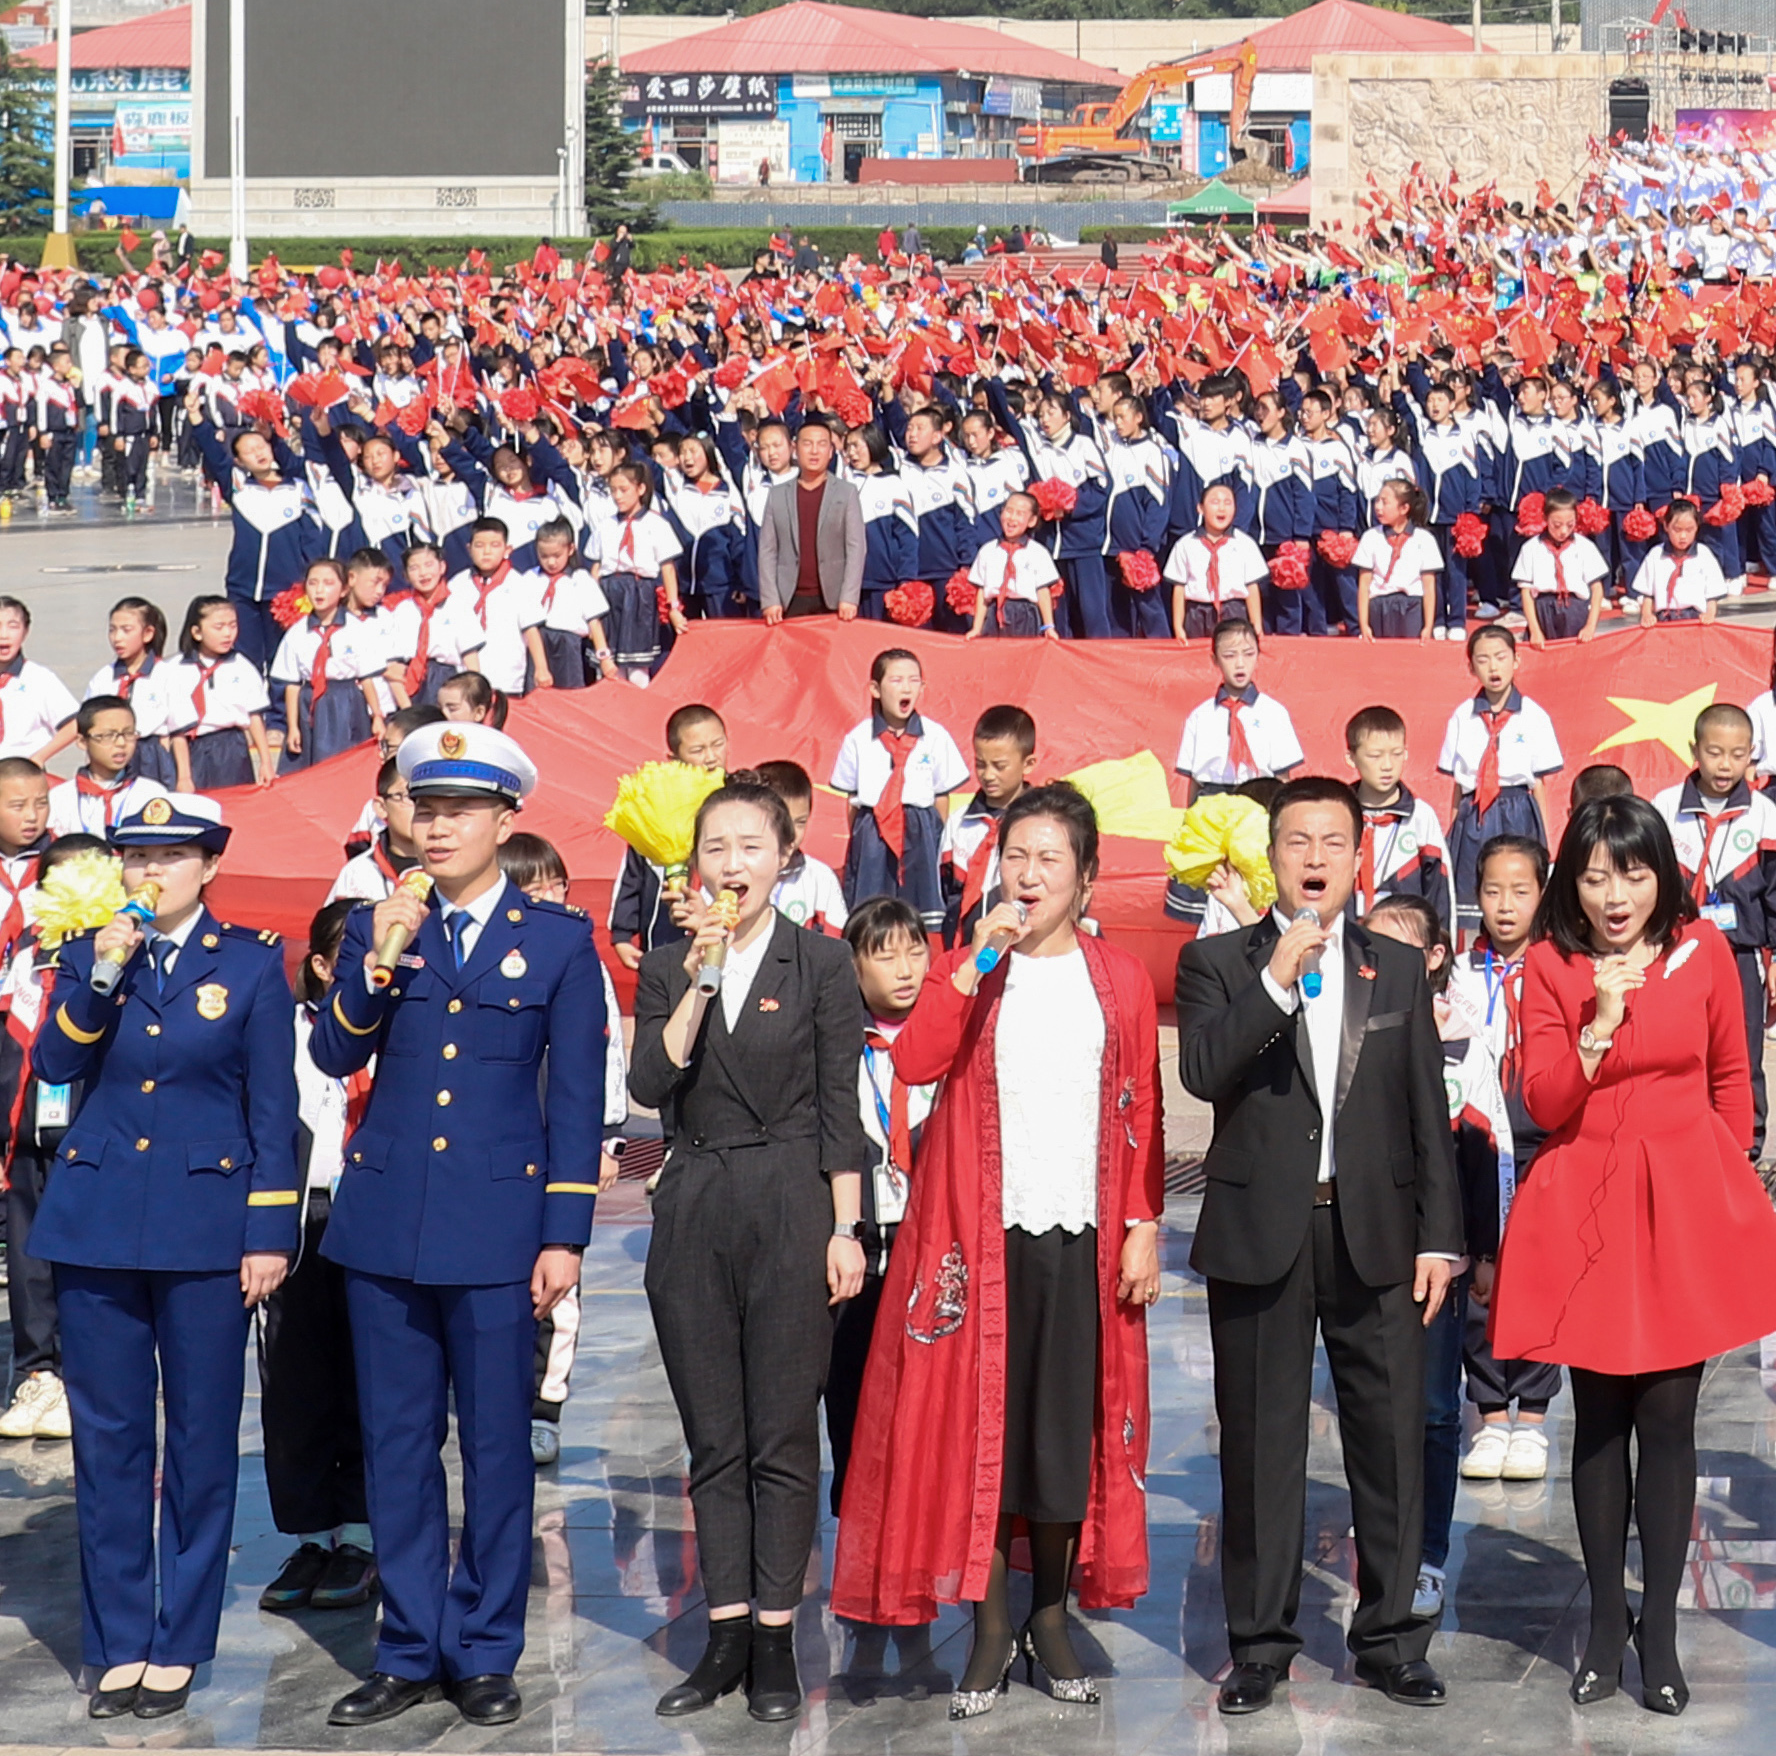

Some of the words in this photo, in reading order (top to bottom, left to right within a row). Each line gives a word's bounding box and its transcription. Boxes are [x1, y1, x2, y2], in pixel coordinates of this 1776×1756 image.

[646, 74, 770, 101] 爱丽莎壁纸
